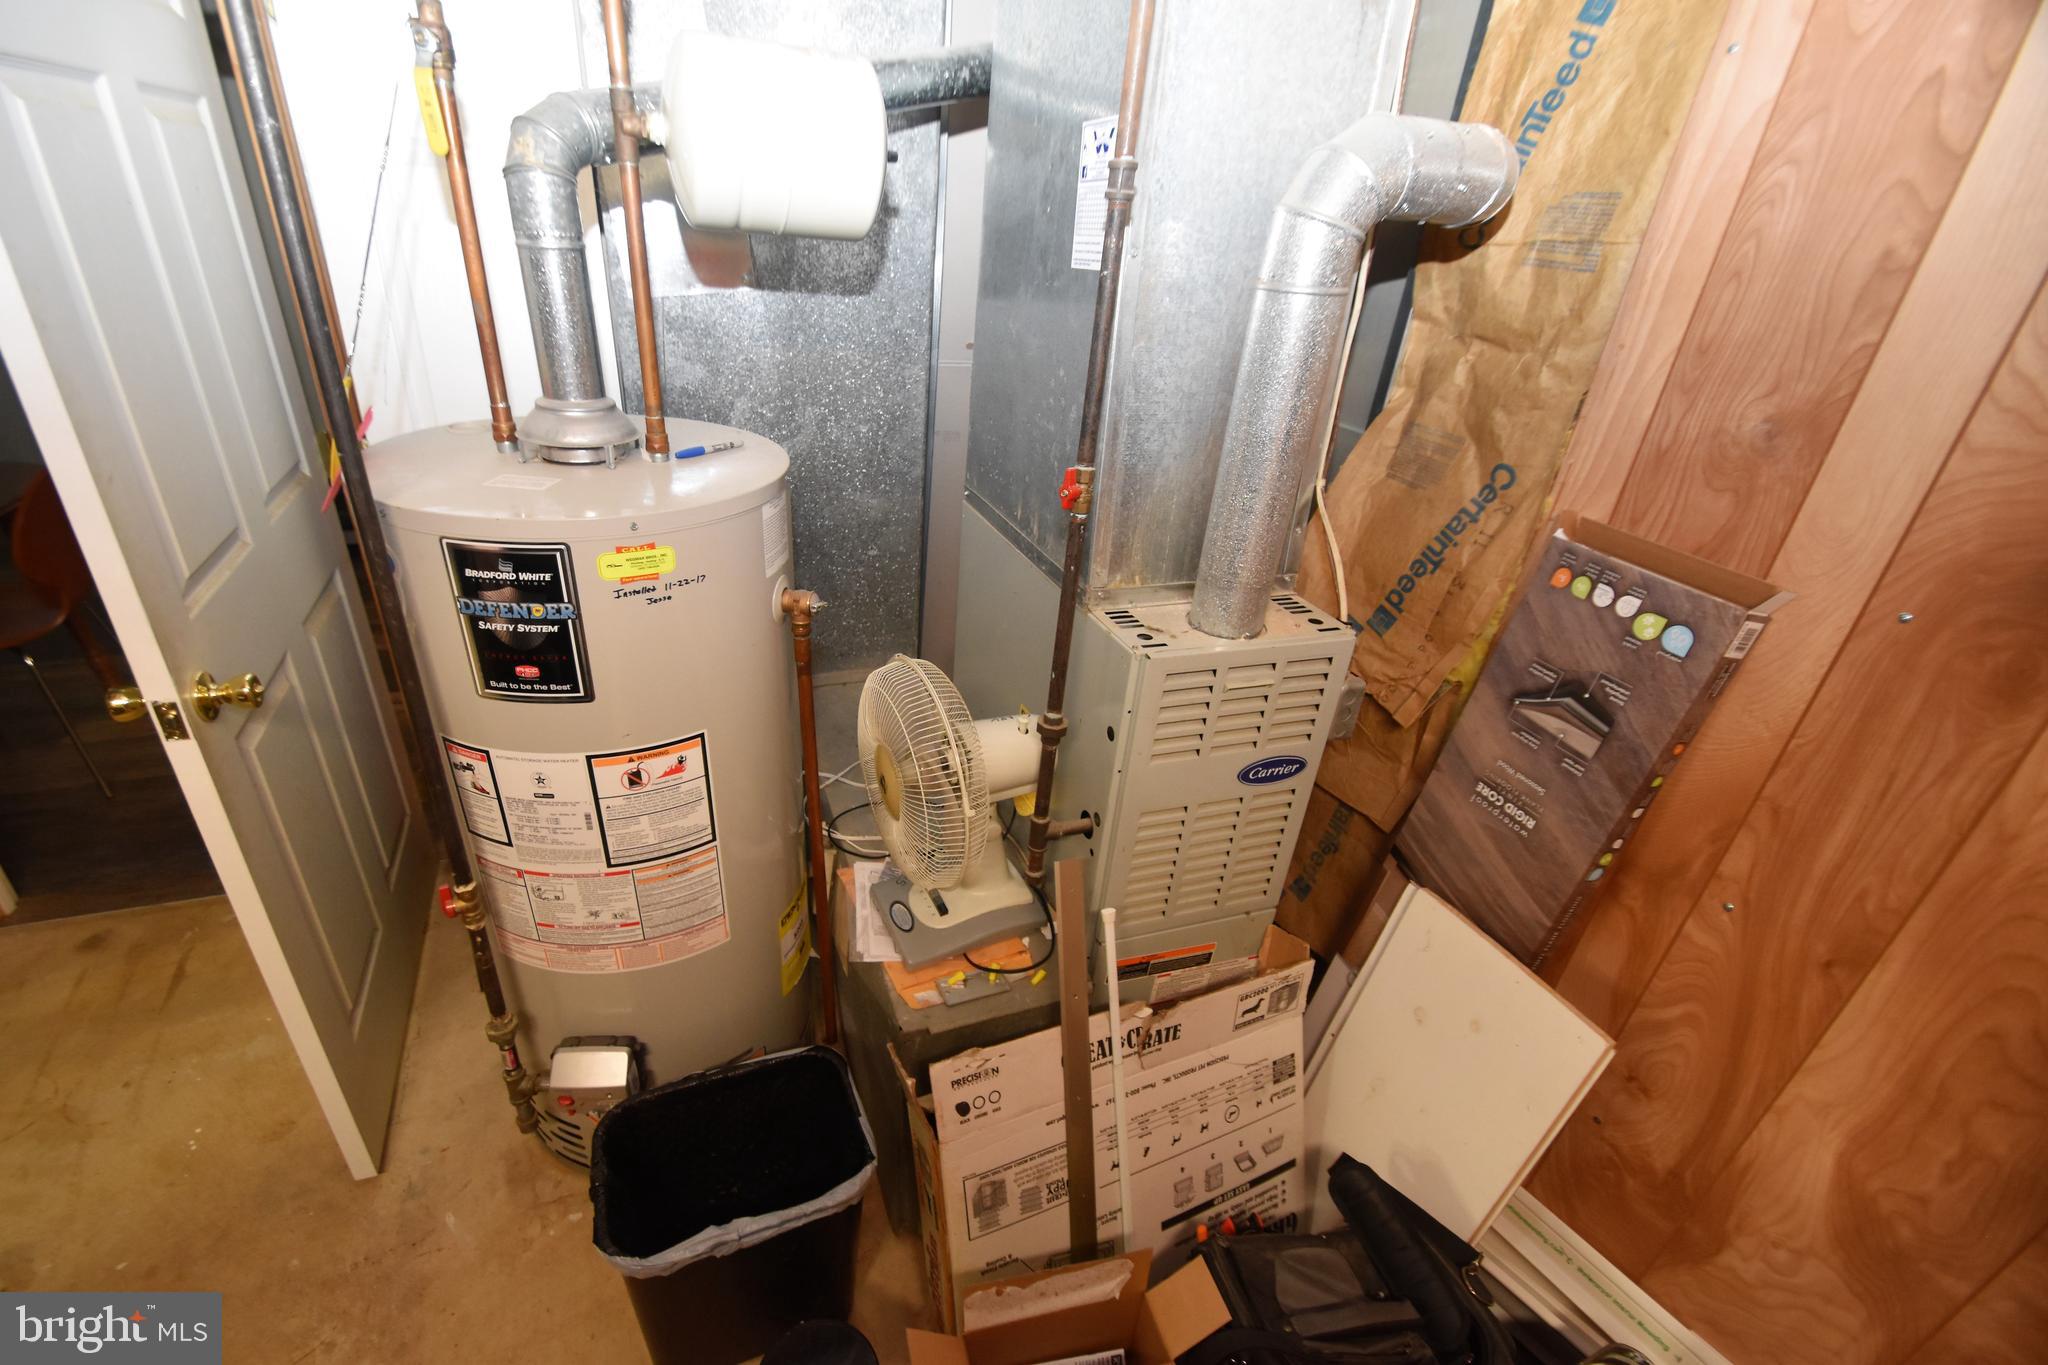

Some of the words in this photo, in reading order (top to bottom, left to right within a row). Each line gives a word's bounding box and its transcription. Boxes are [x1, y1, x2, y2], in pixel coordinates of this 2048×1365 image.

[1384, 463, 1517, 614] CertainTeed
[464, 567, 517, 580] BRADFORD
[518, 572, 552, 581] WHITE
[613, 585, 657, 599] Installed
[664, 574, 707, 592] 11-22-17
[458, 597, 577, 620] DEFENDER
[478, 620, 514, 632] SAFETY
[517, 623, 560, 633] SYSTEM
[489, 680, 508, 689] Built
[509, 682, 519, 690] to
[550, 683, 572, 691] Best
[636, 749, 670, 761] WARNING
[1249, 763, 1300, 779] Carrier
[1476, 781, 1505, 807] CORE
[1469, 793, 1529, 839] waterproof
[1504, 803, 1537, 830] RIGID
